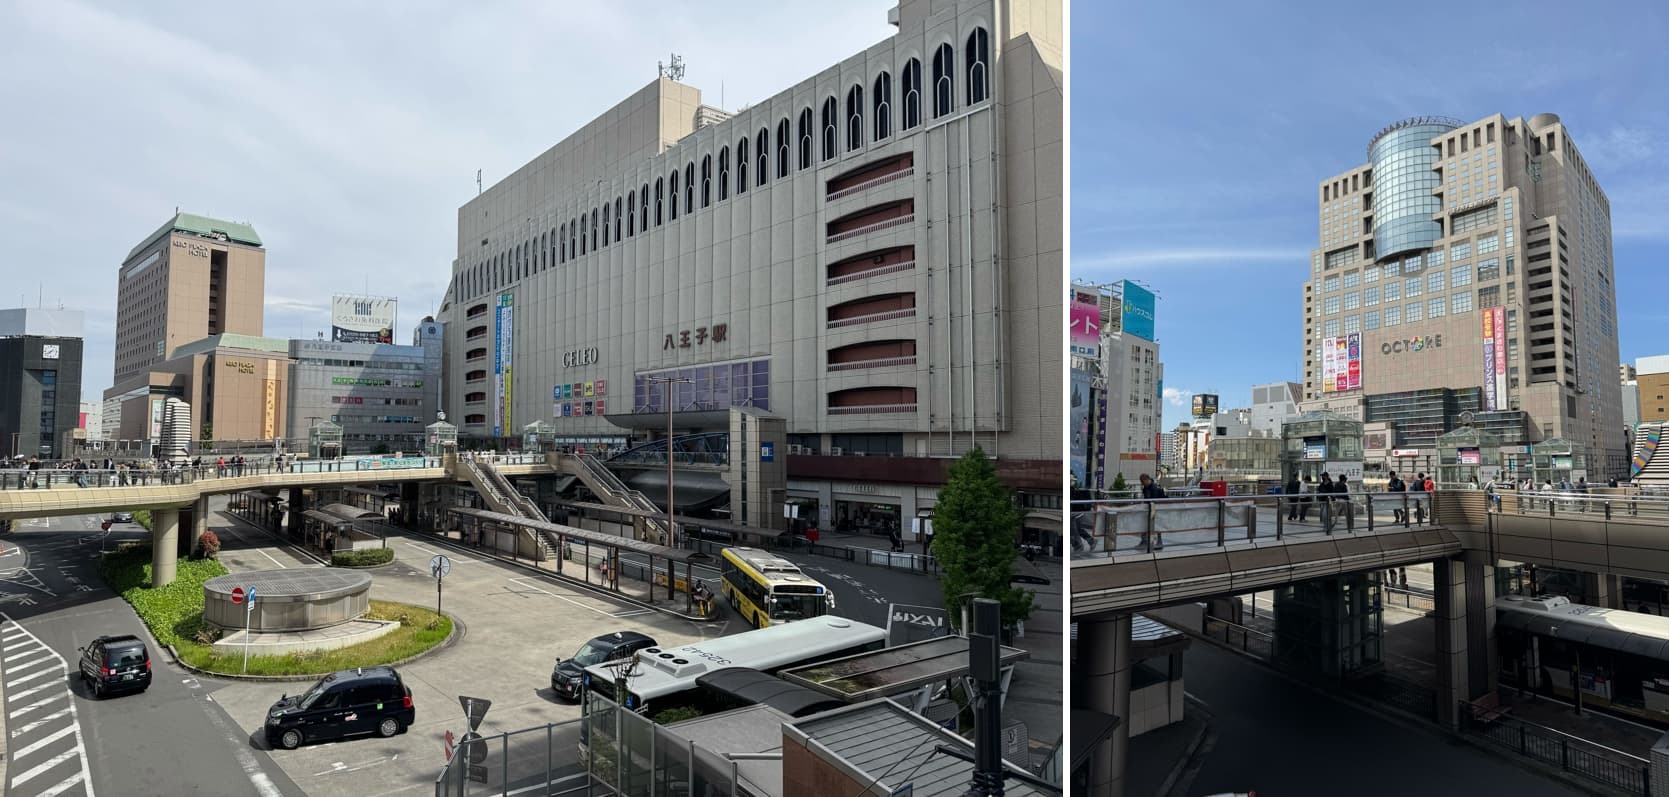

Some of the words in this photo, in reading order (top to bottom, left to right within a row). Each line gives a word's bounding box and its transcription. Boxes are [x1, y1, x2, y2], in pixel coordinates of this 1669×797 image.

[188, 250, 208, 258] HOTEL
[663, 323, 728, 351] 八王子駅
[1381, 333, 1442, 355] OCTORE
[562, 346, 599, 368] CELEO
